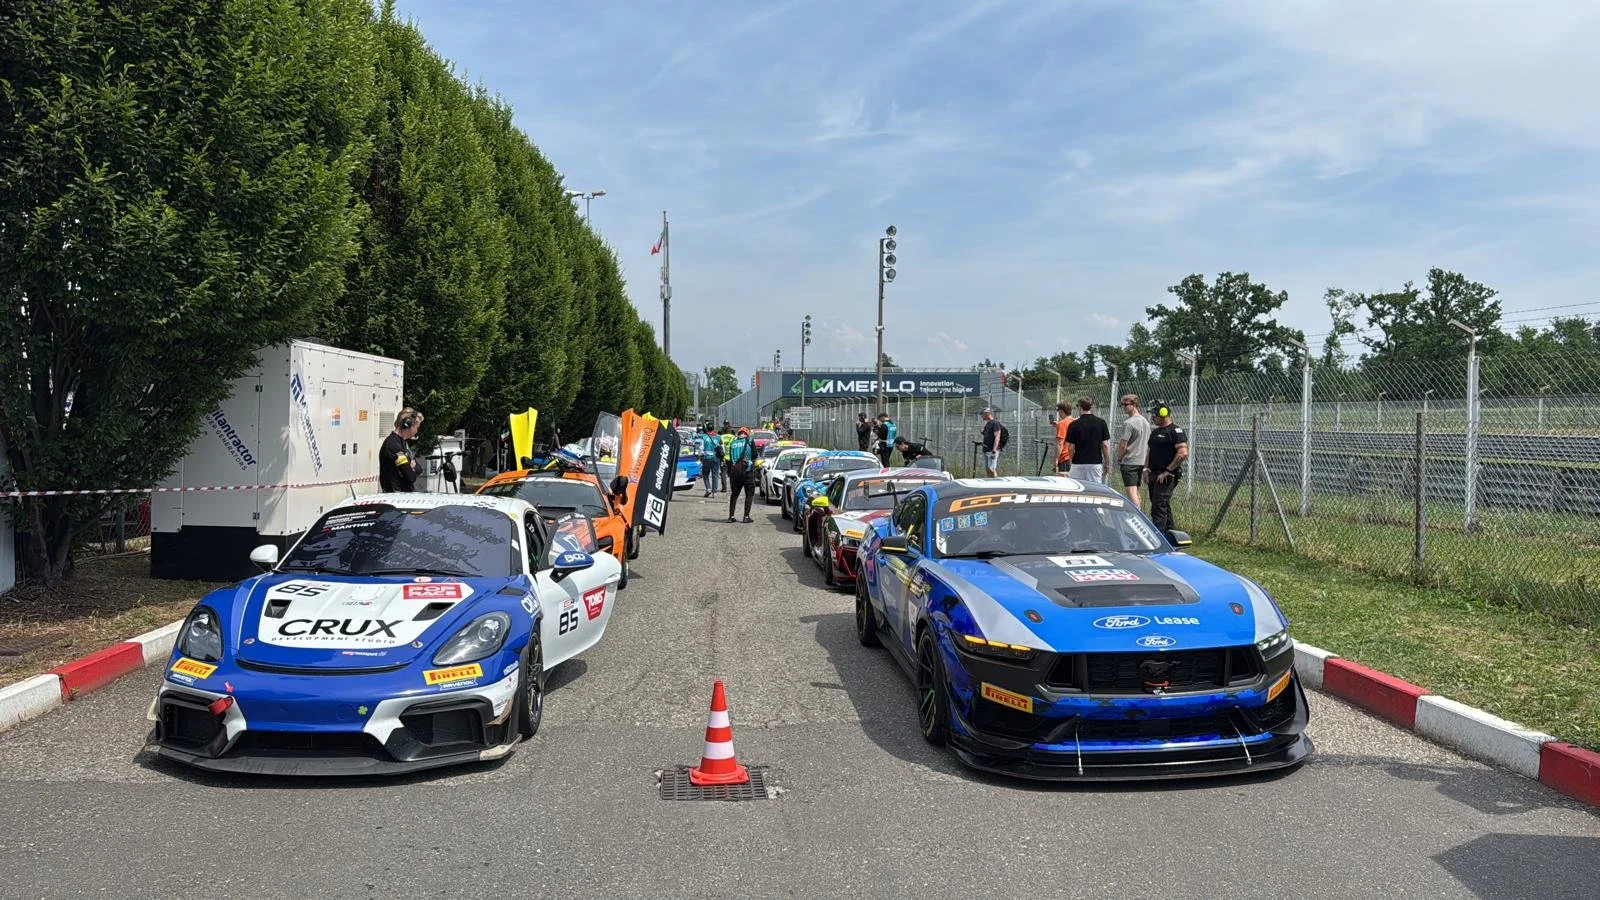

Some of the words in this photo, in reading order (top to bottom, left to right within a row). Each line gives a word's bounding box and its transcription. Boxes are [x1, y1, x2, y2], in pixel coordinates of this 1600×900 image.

[836, 380, 916, 393] MERLO
[208, 408, 257, 466] ilantractor
[298, 394, 322, 471] Mantractor
[215, 429, 248, 471] GENERATORS
[655, 443, 670, 490] sellmyride
[1030, 493, 1124, 508] EUROPE
[650, 499, 663, 523] 78
[331, 522, 375, 531] MANTHEY
[275, 584, 328, 597] 85
[521, 591, 540, 614] CRU
[278, 619, 403, 637] CRUX
[559, 608, 578, 635] 85
[1105, 616, 1140, 627] Ford
[1154, 616, 1199, 625] Lease
[1145, 637, 1168, 646] Ford
[176, 660, 210, 675] PIRELLI
[429, 667, 477, 682] PIRELLI
[985, 687, 1028, 710] PIRELLI
